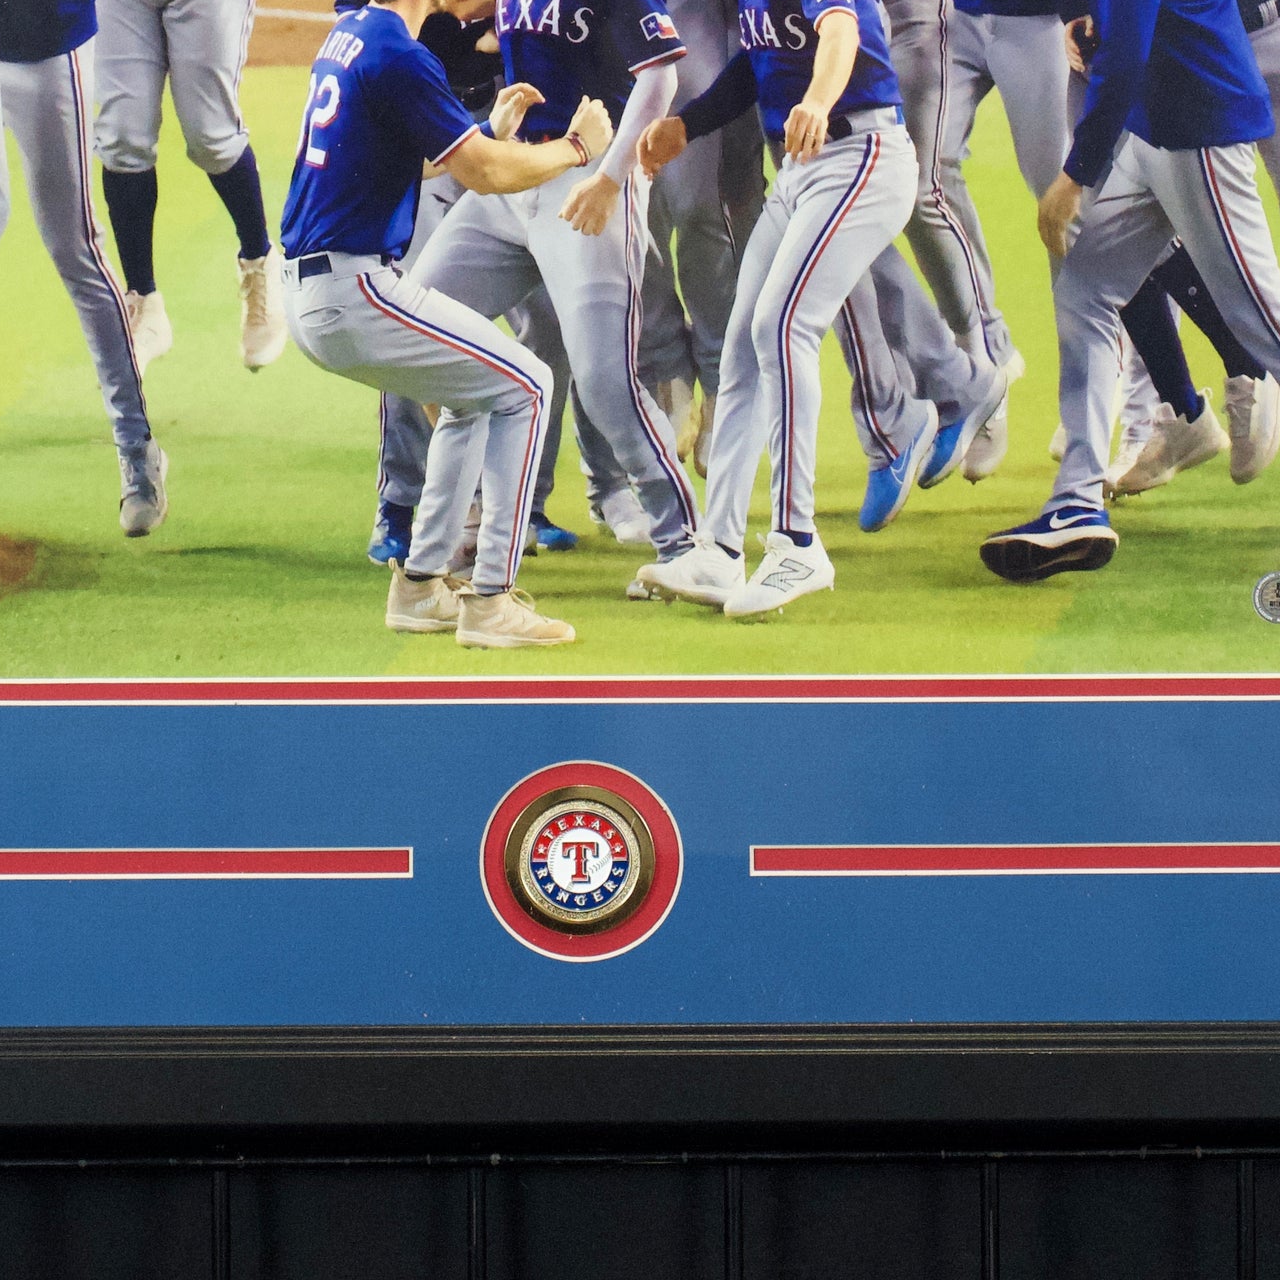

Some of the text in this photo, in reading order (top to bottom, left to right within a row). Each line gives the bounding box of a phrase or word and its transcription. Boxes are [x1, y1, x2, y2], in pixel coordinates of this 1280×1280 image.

[543, 814, 616, 841] TEXAS
[561, 841, 600, 884] T
[535, 866, 626, 907] RANGERS
